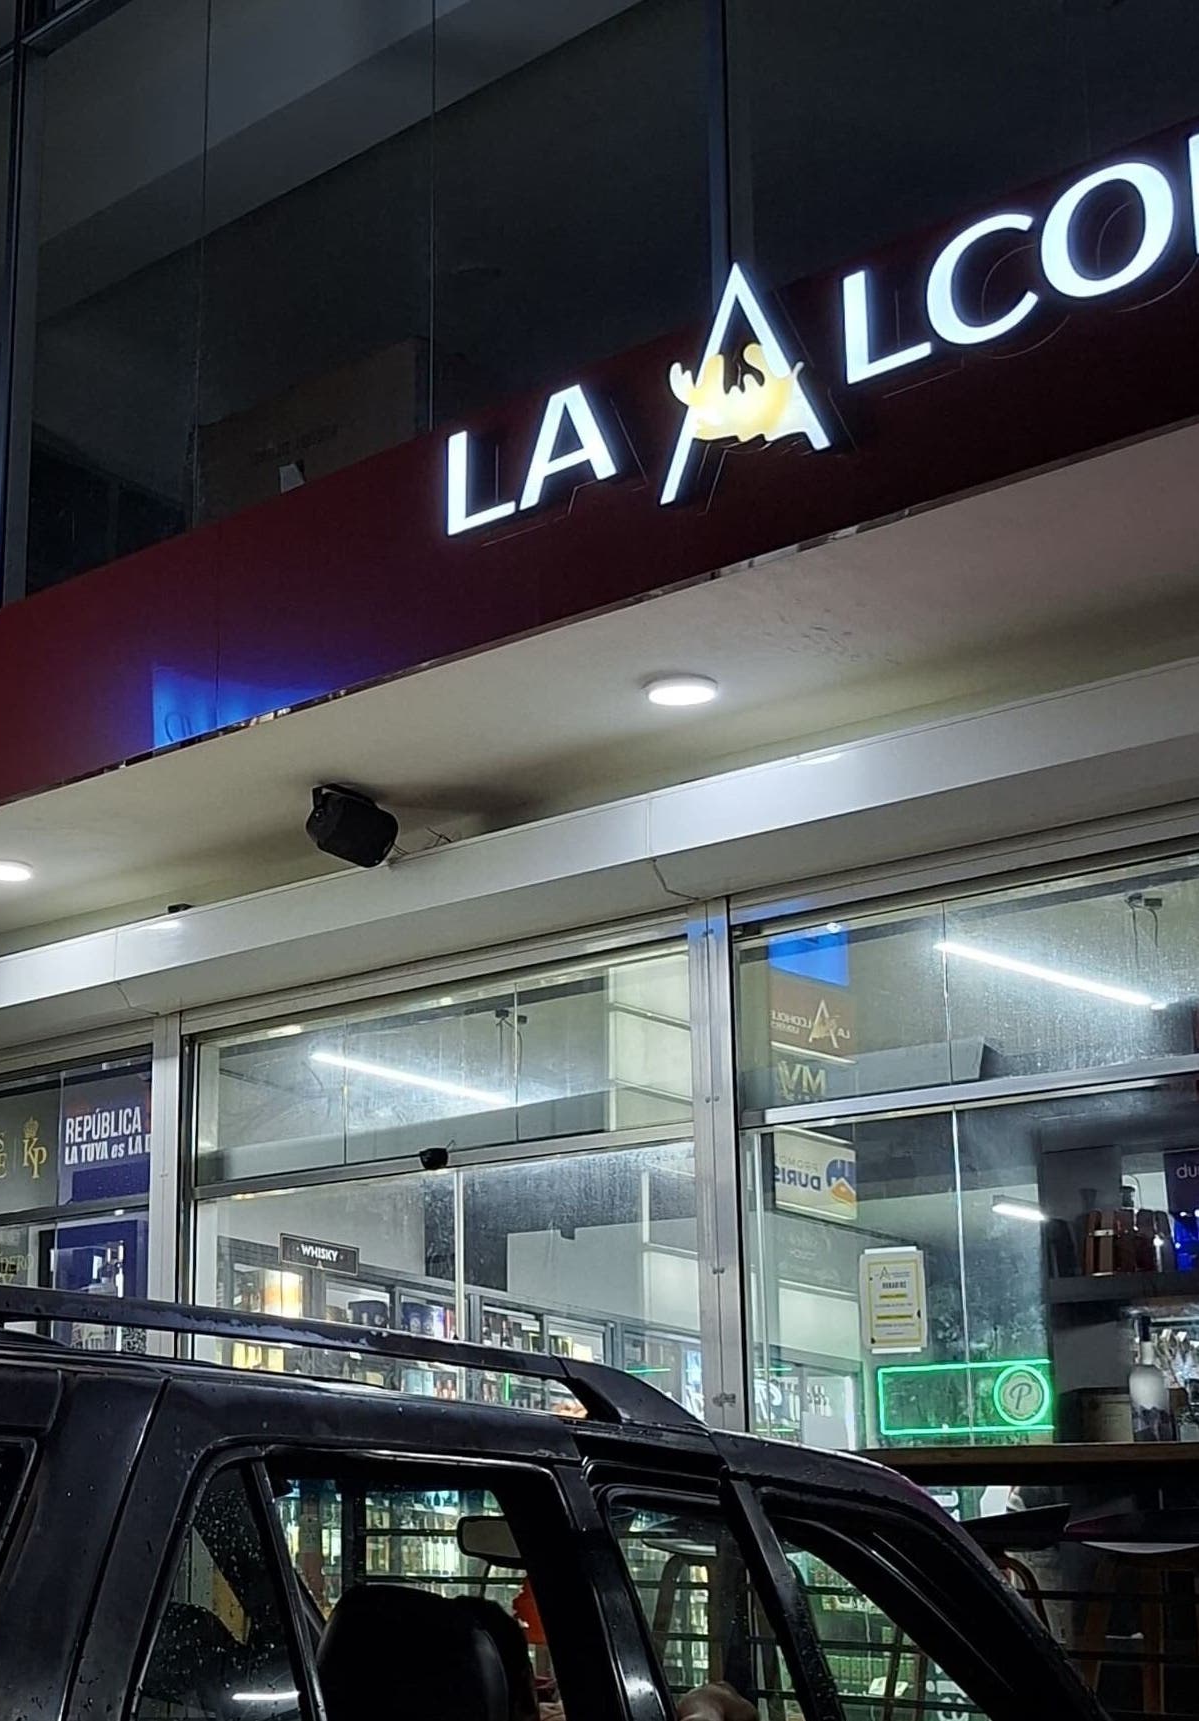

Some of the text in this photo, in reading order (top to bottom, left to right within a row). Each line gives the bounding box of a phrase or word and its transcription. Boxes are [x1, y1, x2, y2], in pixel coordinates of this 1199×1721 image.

[447, 132, 1199, 536] LA ALCO
[65, 1106, 142, 1144] REPÚBLICA
[64, 1145, 78, 1165] LA
[80, 1141, 109, 1163] TUYA
[111, 1143, 125, 1159] es
[128, 1135, 142, 1155] LA
[1176, 1163, 1199, 1178] du
[301, 1243, 338, 1262] WHISKY
